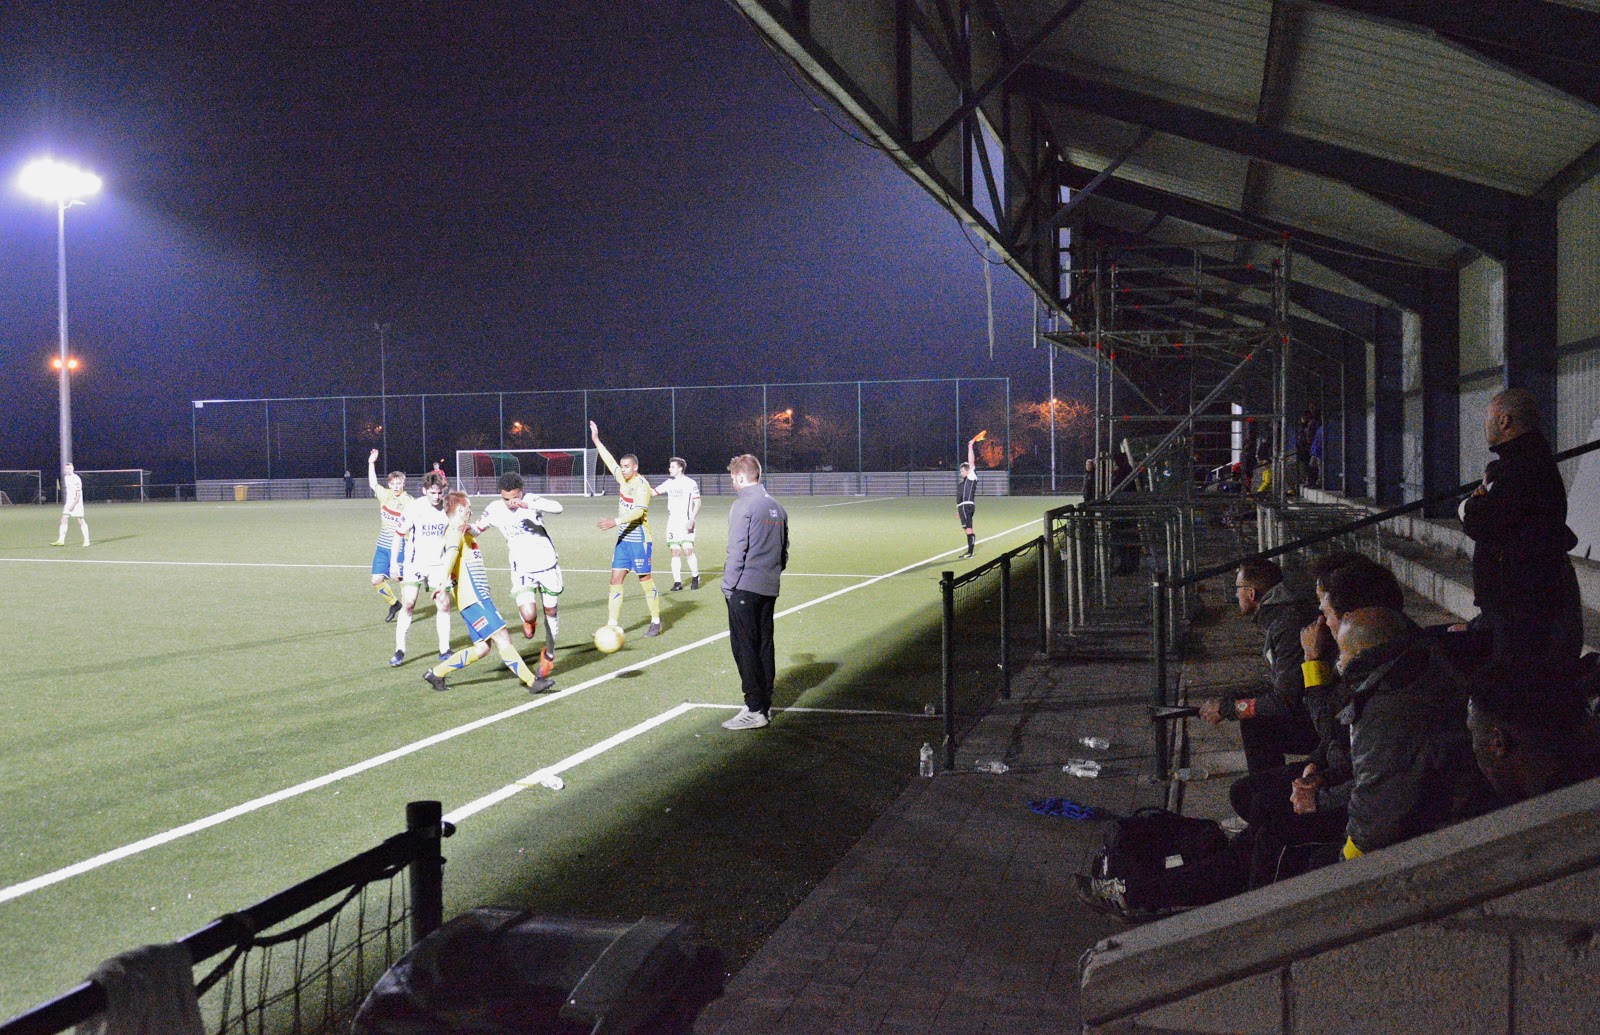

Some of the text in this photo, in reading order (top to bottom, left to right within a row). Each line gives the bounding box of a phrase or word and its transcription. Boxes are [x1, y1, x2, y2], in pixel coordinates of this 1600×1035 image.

[422, 523, 444, 531] KING
[668, 532, 674, 540] 3
[415, 571, 422, 580] 4
